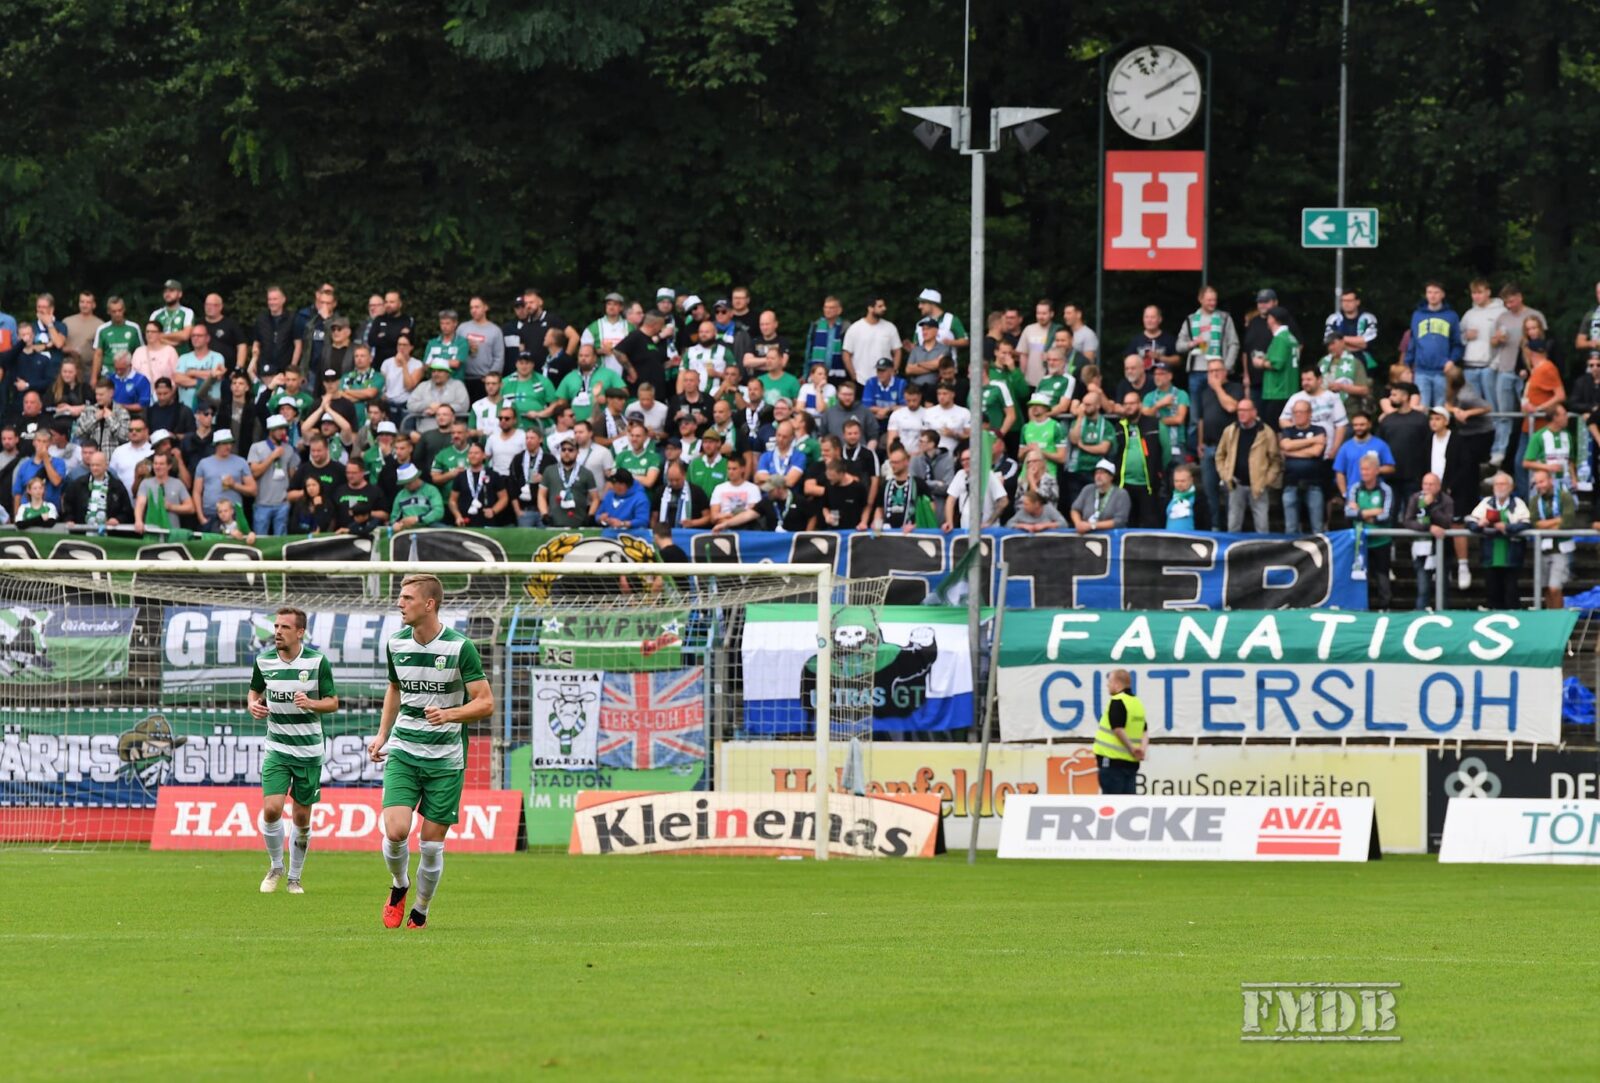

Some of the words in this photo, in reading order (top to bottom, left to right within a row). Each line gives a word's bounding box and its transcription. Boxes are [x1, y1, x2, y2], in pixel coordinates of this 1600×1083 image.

[1046, 613, 1520, 661] FANATICS
[401, 682, 446, 692] MENSE
[810, 686, 886, 708] TRAS
[893, 686, 926, 709] GT
[0, 724, 121, 782] ÄRTS
[531, 775, 612, 787] STADION
[1550, 772, 1600, 800] DE
[559, 794, 576, 808] H
[593, 799, 912, 857] Kleinemas
